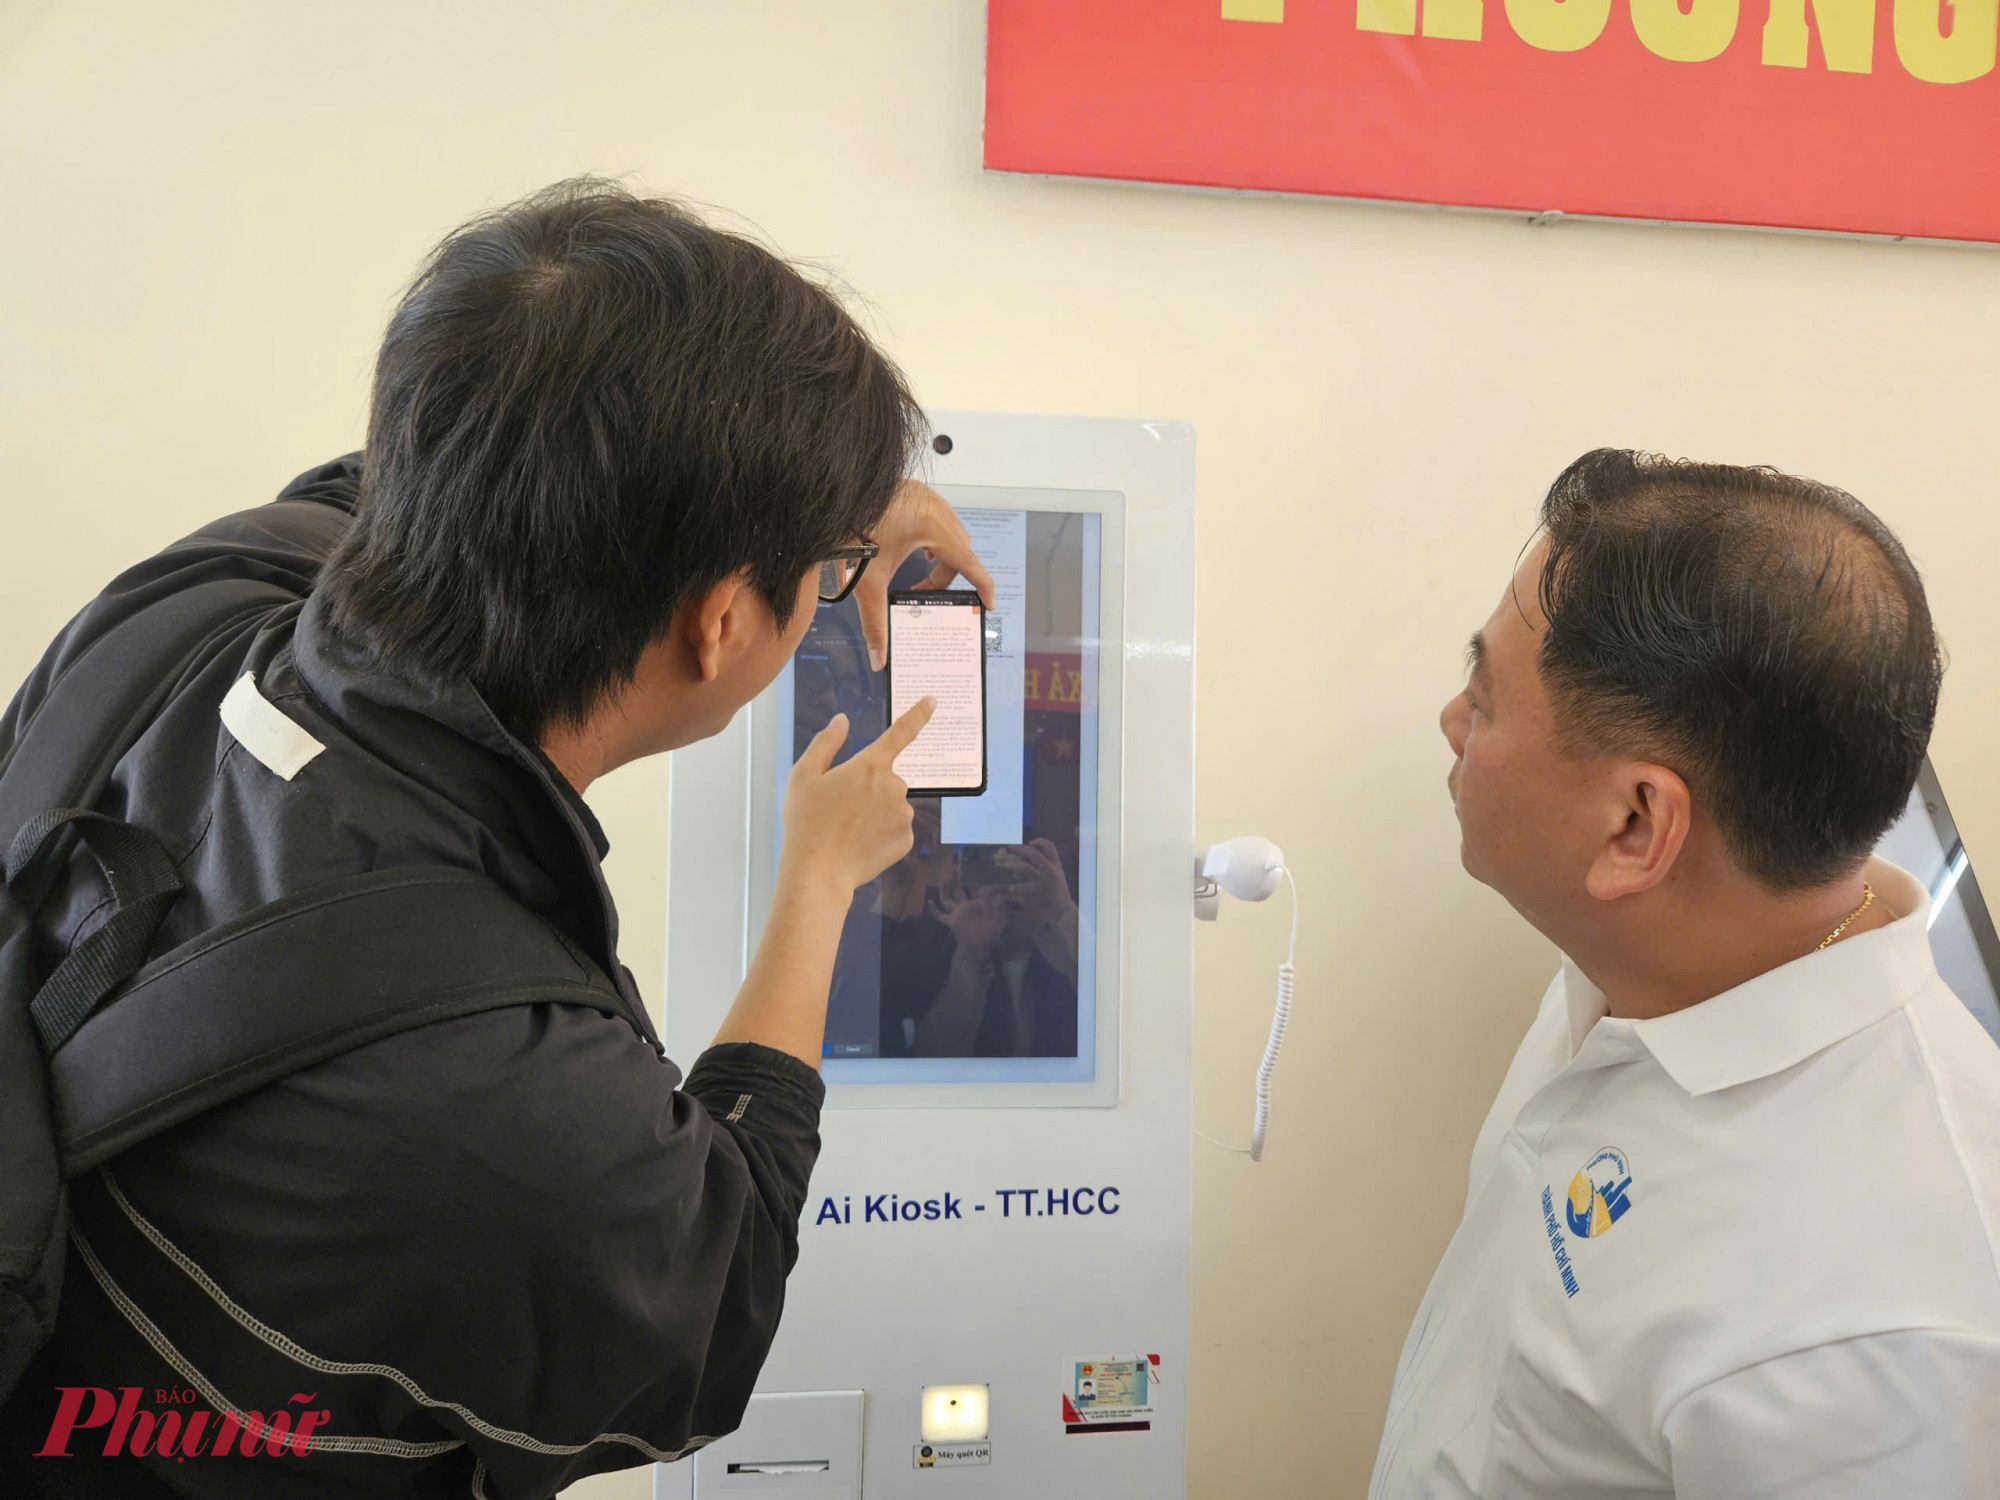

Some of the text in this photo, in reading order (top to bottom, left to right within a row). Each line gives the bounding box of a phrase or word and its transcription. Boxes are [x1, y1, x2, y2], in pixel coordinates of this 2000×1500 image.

[816, 1196, 850, 1225] Ai
[864, 1192, 962, 1223] Kiosk
[996, 1186, 1120, 1217] TT.HCC
[1541, 1184, 1580, 1299] THÀNH PHỐ HỒ CHÍ MINH
[938, 1448, 989, 1459] Máy quét QR
